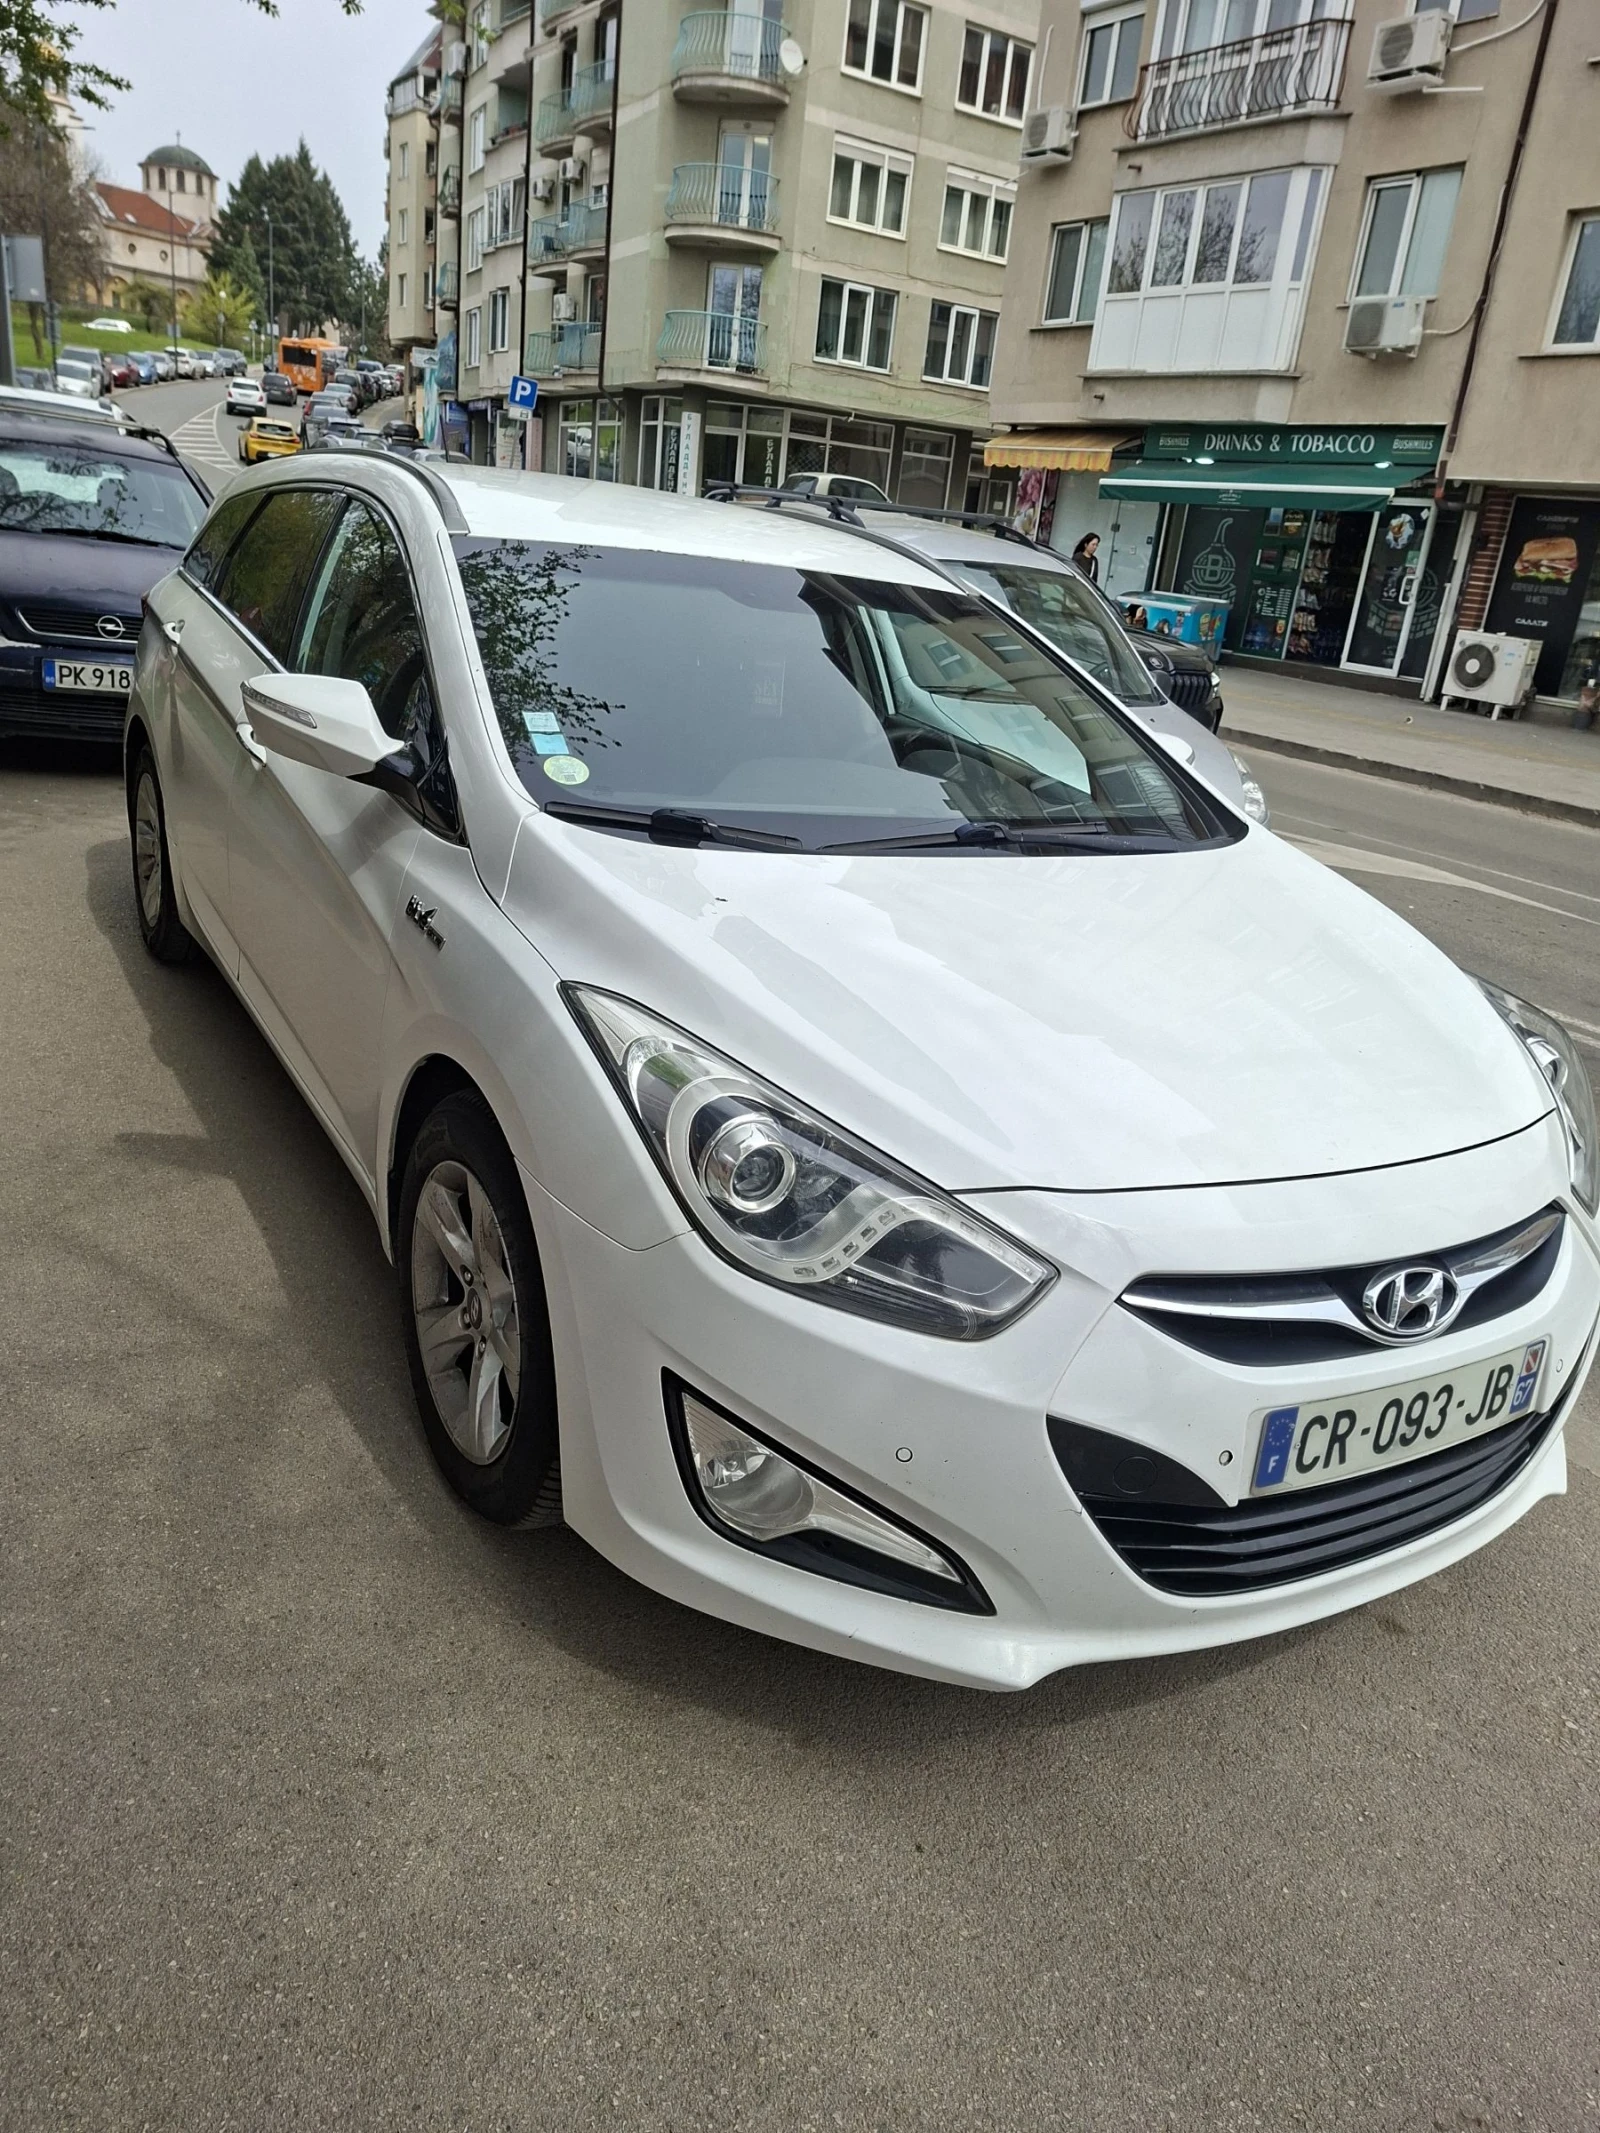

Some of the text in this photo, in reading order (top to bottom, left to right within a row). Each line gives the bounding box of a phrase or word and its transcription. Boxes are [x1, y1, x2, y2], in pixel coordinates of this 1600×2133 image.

[515, 380, 532, 402] P
[1204, 433, 1375, 454] DRINKS & TOBACCO
[1393, 438, 1434, 450] BUSHMILLS
[1513, 1378, 1534, 1407] 67
[1295, 1363, 1515, 1475] CR-093-JB
[1267, 1454, 1280, 1474] F
